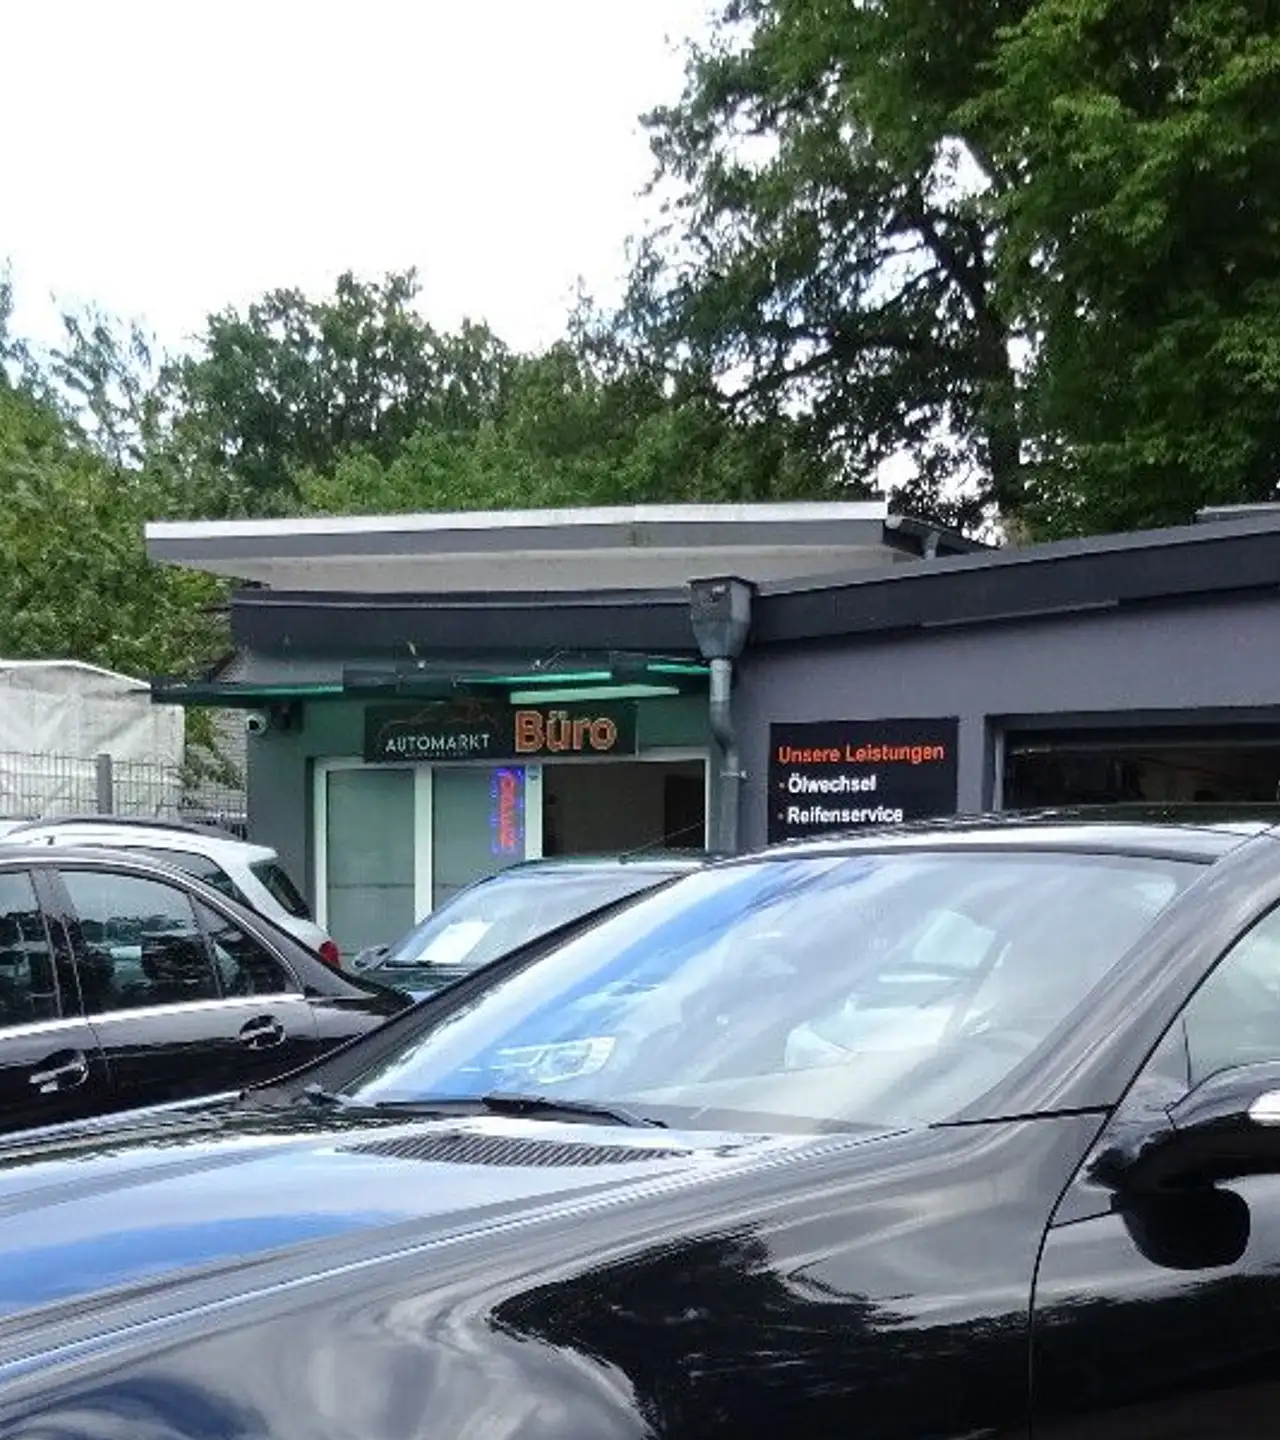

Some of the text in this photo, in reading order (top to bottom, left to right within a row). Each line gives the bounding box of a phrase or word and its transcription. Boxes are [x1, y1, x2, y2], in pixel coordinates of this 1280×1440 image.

[515, 710, 617, 752] Büro
[385, 733, 490, 753] AUTOMARKT
[779, 743, 944, 765] Unsere Leistungen
[788, 773, 877, 793] Ölwechsel
[786, 804, 903, 824] Reifenservice
